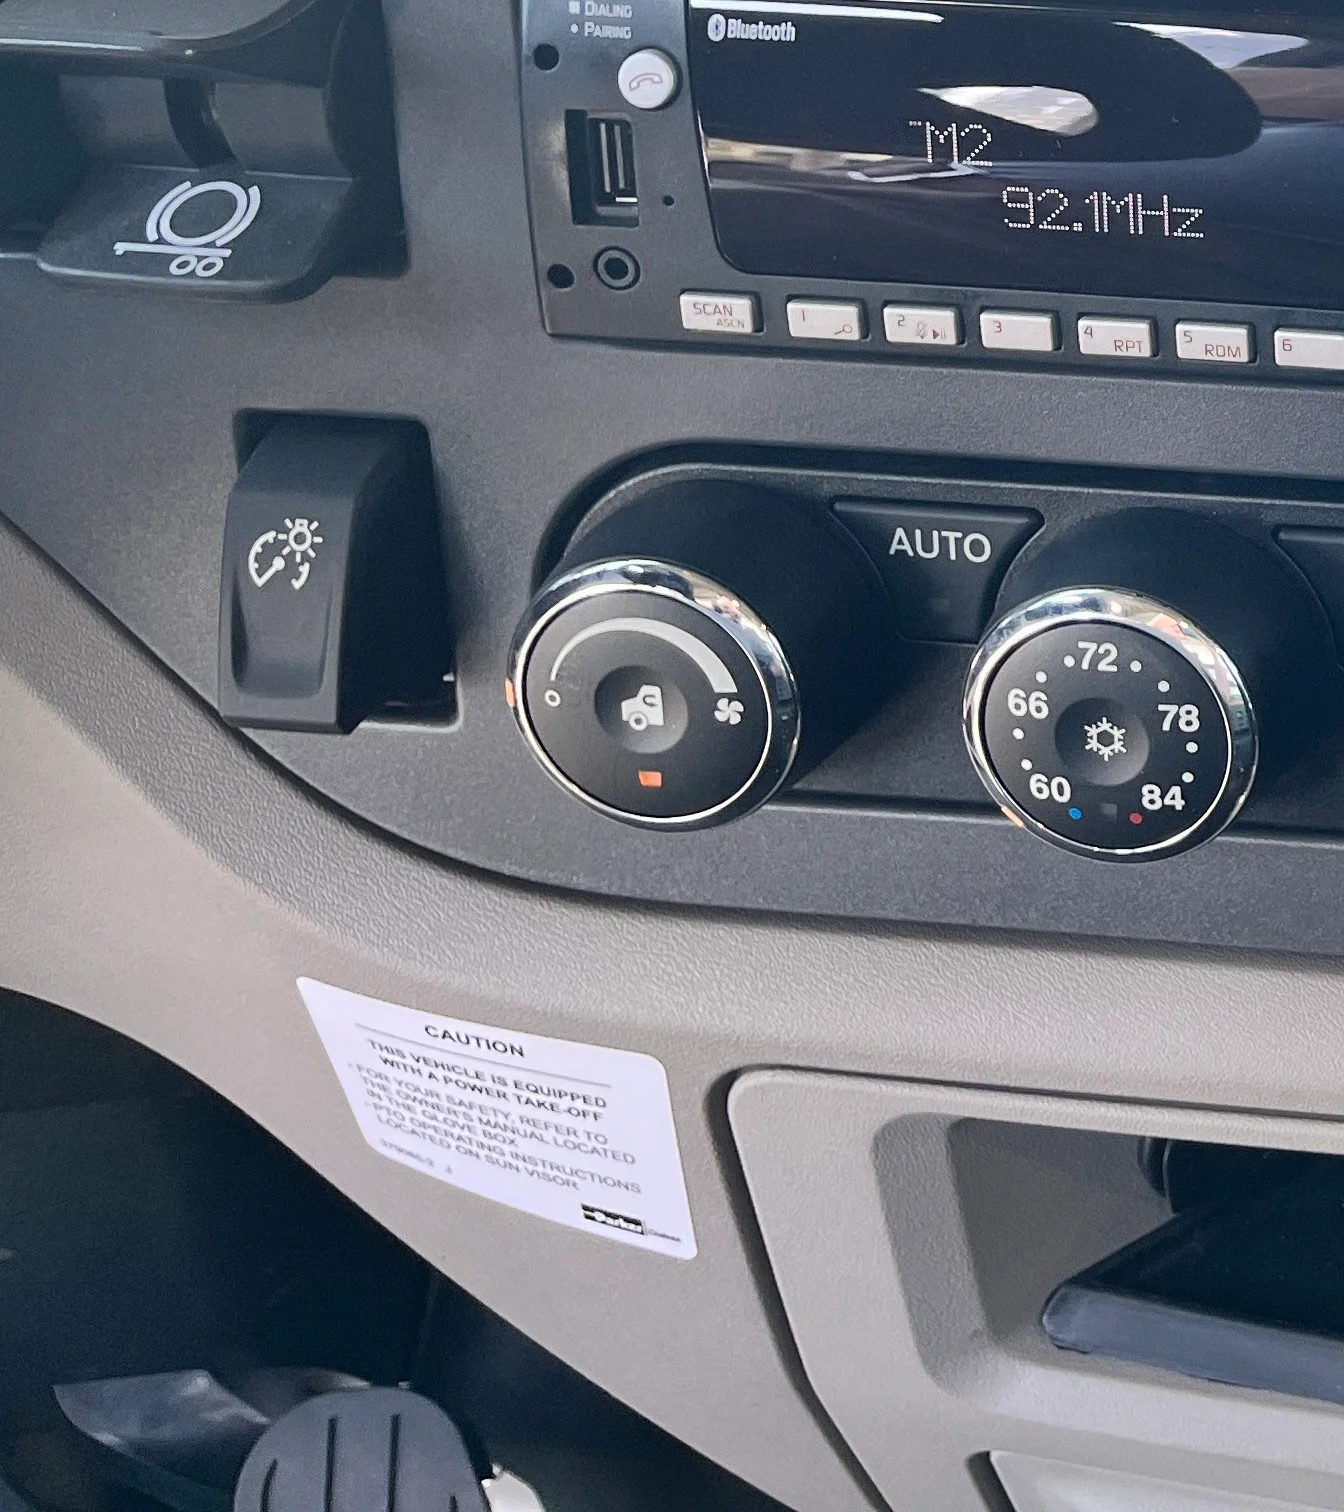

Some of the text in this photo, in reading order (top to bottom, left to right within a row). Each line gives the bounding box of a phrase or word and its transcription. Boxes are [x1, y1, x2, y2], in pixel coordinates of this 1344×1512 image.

[727, 18, 796, 42] Bluetooth
[1002, 185, 1204, 238] 92.1MHz
[693, 302, 734, 318] SCAN
[897, 315, 906, 327] 2
[993, 321, 1002, 333] 3
[1083, 325, 1094, 339] 4
[1183, 330, 1193, 344] 5
[1114, 340, 1144, 354] RPT
[1204, 343, 1242, 359] RDM
[1281, 339, 1292, 353] 6
[889, 527, 992, 564] AUTO
[1077, 643, 1118, 672] 72
[1007, 688, 1049, 719] 66
[1158, 704, 1200, 734] 78
[1029, 773, 1071, 803] 60
[1141, 783, 1185, 811] 84
[424, 1024, 525, 1058] CAUTION
[367, 1038, 607, 1109] THIS VEHICLE IS EQUIPPED
[378, 1054, 604, 1122] WITH A POWER TAKE-OFF
[356, 1063, 391, 1084] FOR
[393, 1076, 441, 1101] YOUR
[519, 1115, 579, 1138] REFER
[583, 1131, 609, 1146] TO
[361, 1075, 393, 1093] THE
[477, 1116, 550, 1145] MANUAL
[553, 1136, 636, 1165] LOCATED
[387, 1095, 417, 1115] THE
[420, 1109, 478, 1136] GLOVE
[482, 1128, 519, 1148] BOX
[376, 1113, 451, 1150] LOCATED
[455, 1144, 482, 1160] ON
[484, 1154, 521, 1173] SUN
[524, 1166, 580, 1191] VISOR
[409, 1116, 506, 1157] OPERATING
[510, 1151, 642, 1194] INSTRUCTIONS
